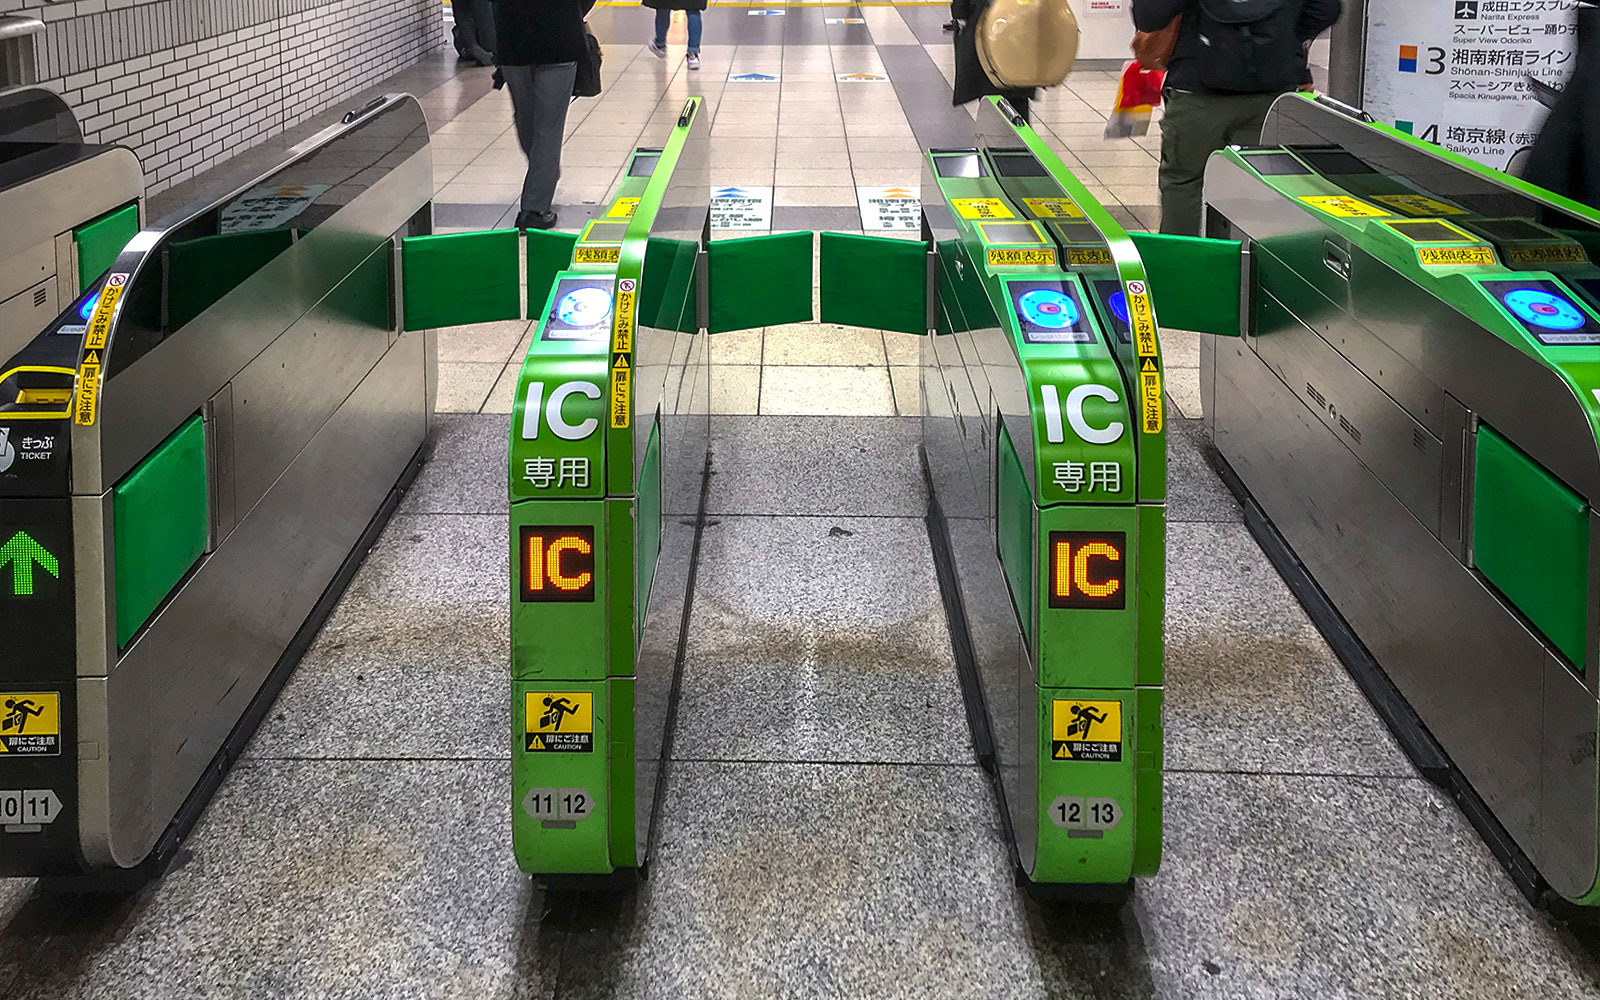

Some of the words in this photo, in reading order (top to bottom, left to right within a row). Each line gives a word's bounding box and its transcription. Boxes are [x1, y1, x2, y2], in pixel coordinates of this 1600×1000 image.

[1481, 13, 1505, 21] Narita
[1508, 13, 1540, 21] Express
[1454, 24, 1578, 35] スーパービュー踊り子
[1453, 37, 1476, 45] Super
[1425, 47, 1447, 75] 3
[1451, 49, 1572, 66] 湘南新宿ライン
[1451, 66, 1539, 78] Shōnan-Shinjuku
[1541, 67, 1563, 77] Line
[1449, 92, 1476, 100] Spacia
[1478, 93, 1520, 101] Kinugawa,
[1420, 124, 1441, 146] 4
[1446, 143, 1480, 155] Saikyō
[1483, 146, 1505, 155] Line
[88, 287, 119, 347] かけこみ禁止
[616, 292, 632, 350] かけこみ禁止
[1132, 294, 1154, 354] かけこみ禁止
[78, 367, 97, 423] 扉にご注意
[613, 371, 628, 425] 扉にご注意
[1144, 375, 1160, 431] 扉にご注意
[522, 381, 602, 441] IC
[1040, 384, 1124, 444] IC
[20, 451, 52, 460] TICKET
[522, 456, 590, 488] 専用
[1052, 460, 1121, 493] 専用
[530, 536, 591, 591] IC
[1056, 542, 1120, 597] IC
[9, 736, 56, 746] 扉にご注意
[545, 733, 590, 744] 扉にご注意
[1072, 742, 1118, 753] 扉にご注意
[1081, 752, 1110, 760] CAUTION
[28, 796, 49, 817] 11
[532, 794, 552, 814] 11
[563, 794, 586, 814] 12
[1057, 803, 1081, 823] 12
[1091, 803, 1114, 823] 13
